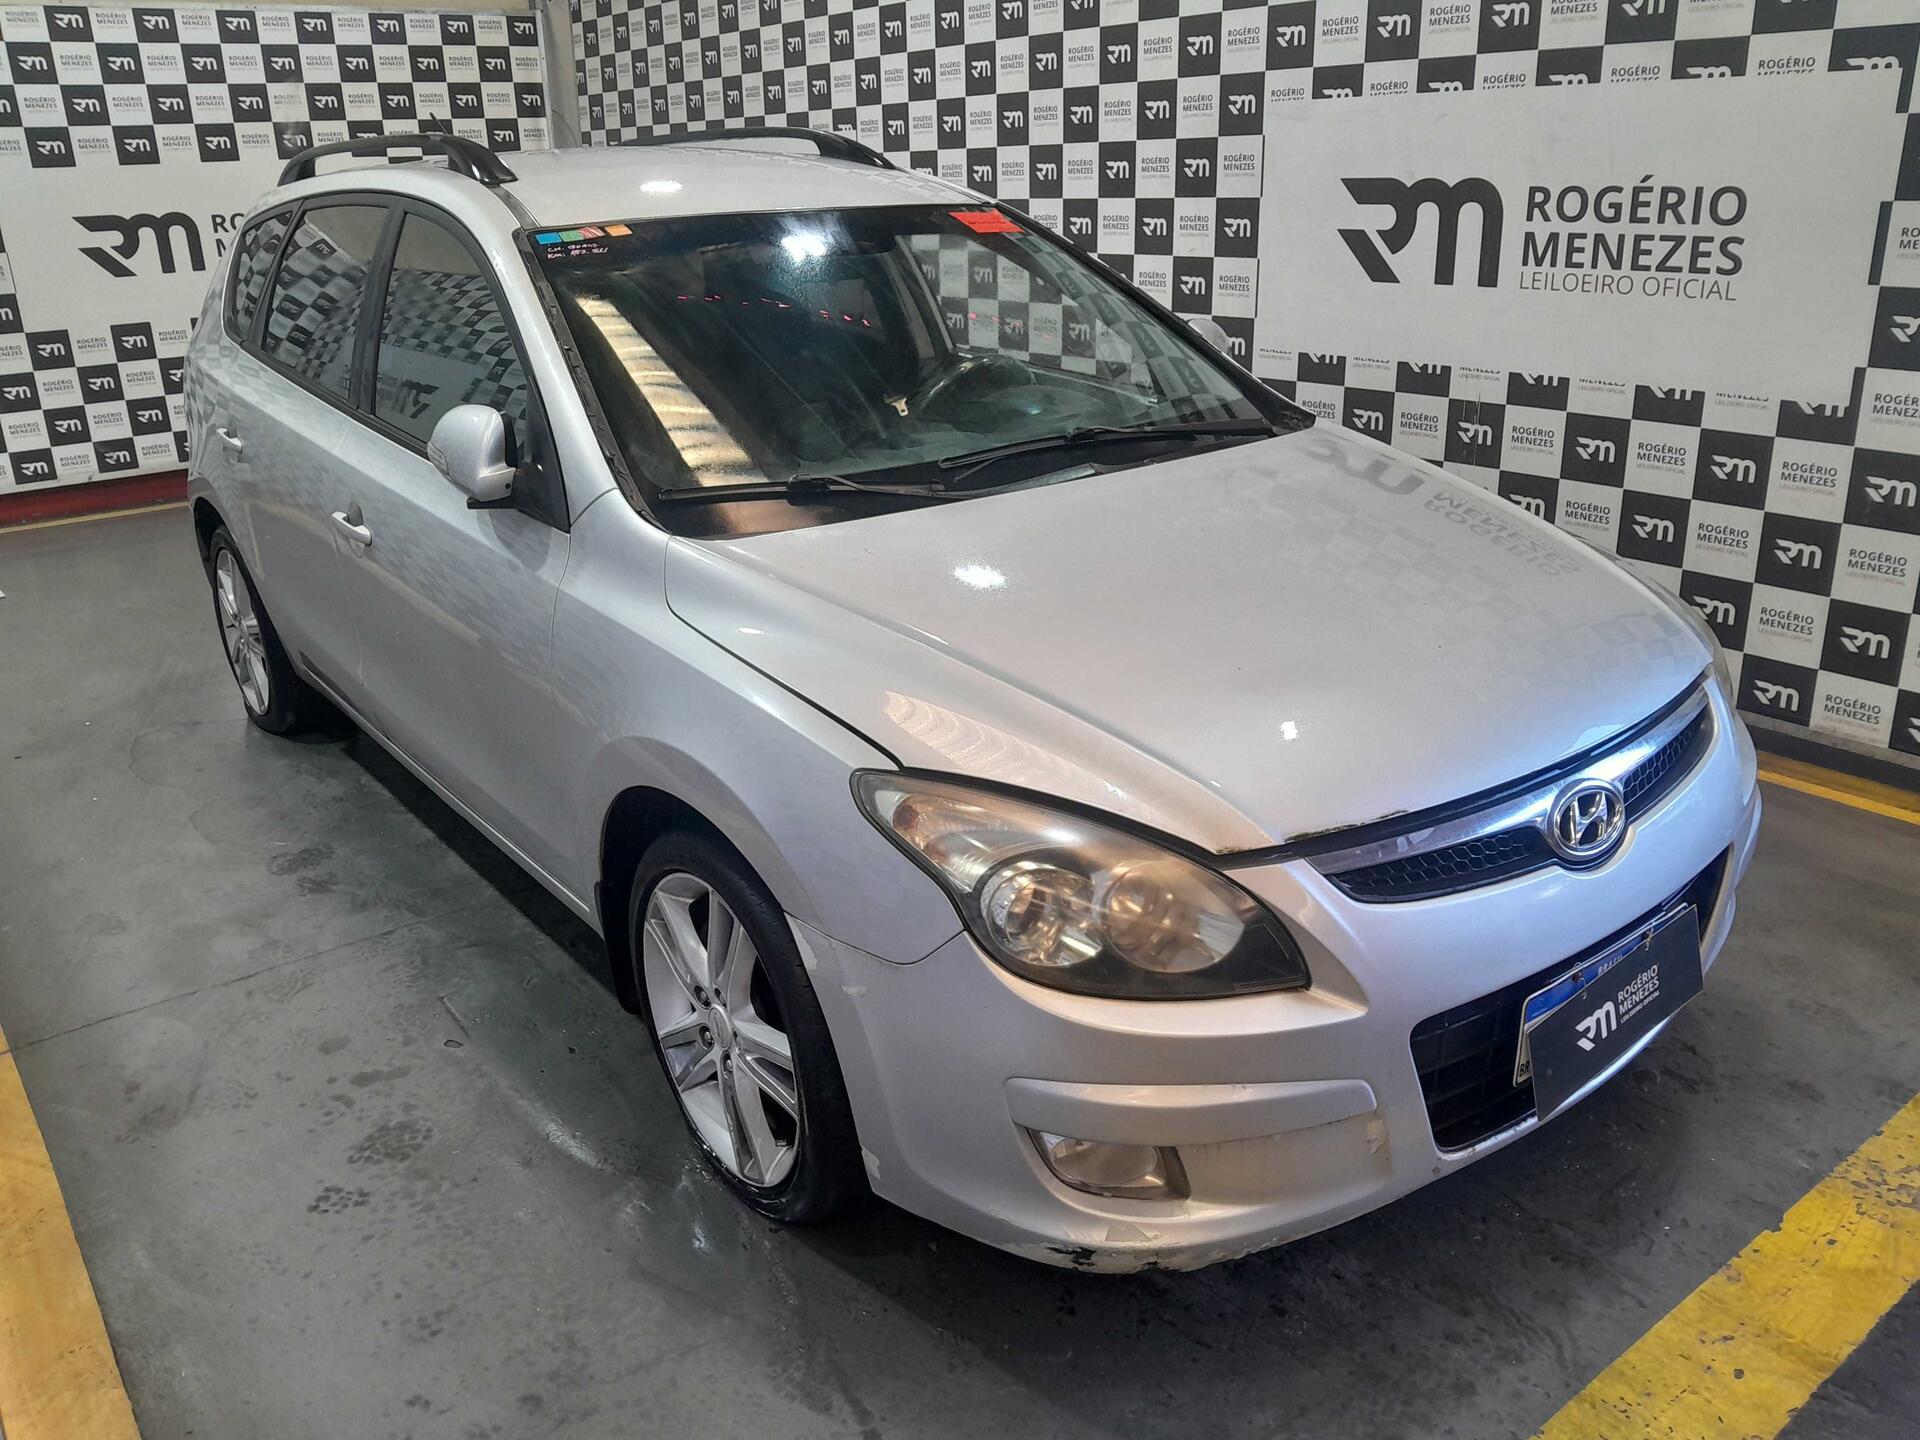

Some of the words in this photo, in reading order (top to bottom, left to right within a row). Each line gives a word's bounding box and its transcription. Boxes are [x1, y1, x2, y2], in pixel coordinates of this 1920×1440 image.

[968, 3, 991, 13] ROGÉRIO
[1429, 4, 1471, 16] ROGÉRIO
[1550, 2, 1598, 15] MENEZES
[968, 10, 991, 20] MENEZES
[1428, 14, 1471, 26] MENEZES
[1322, 15, 1359, 28] ROGÉRIO
[1227, 26, 1260, 38] ROGÉRIO
[1322, 25, 1359, 37] MENEZES
[1143, 36, 1172, 47] ROGÉRIO
[1227, 35, 1260, 46] MENEZES
[1068, 44, 1094, 55] ROGÉRIO
[1143, 44, 1173, 55] MENEZES
[1000, 52, 1024, 62] ROGÉRIO
[1068, 53, 1095, 63] MENEZES
[1758, 55, 1816, 70] ROGÉRIO
[939, 60, 961, 70] ROGÉRIO
[1000, 60, 1024, 70] MENEZES
[1610, 64, 1661, 77] ROGÉRIO
[939, 68, 962, 77] MENEZES
[1482, 72, 1527, 85] ROGÉRIO
[1370, 79, 1409, 92] ROGÉRIO
[1271, 86, 1305, 98] ROGÉRIO
[1104, 98, 1131, 109] ROGÉRIO
[1182, 93, 1213, 104] ROGÉRIO
[1033, 104, 1058, 114] ROGÉRIO
[1104, 108, 1132, 117] MENEZES
[1182, 102, 1213, 112] MENEZES
[1033, 112, 1059, 121] MENEZES
[1068, 158, 1093, 167] ROGÉRIO
[1141, 155, 1170, 165] ROGÉRIO
[1223, 152, 1255, 163] ROGÉRIO
[1067, 167, 1094, 175] MENEZES
[1141, 165, 1170, 173] MENEZES
[1223, 162, 1255, 171] MENEZES
[1524, 174, 1748, 226] ROGÉRIO
[1102, 213, 1130, 223] ROGÉRIO
[1179, 213, 1209, 224] ROGÉRIO
[1102, 222, 1130, 230] MENEZES
[1179, 223, 1209, 232] MENEZES
[1522, 229, 1746, 276] MENEZES
[1138, 270, 1167, 280] ROGÉRIO
[1219, 274, 1250, 284] ROGÉRIO
[1138, 279, 1167, 288] MENEZES
[1218, 283, 1250, 292] MENEZES
[1519, 270, 1634, 297] LEILOEIRO
[1642, 275, 1738, 301] OFICIAL
[1873, 393, 1920, 407] ROGÉR
[1400, 411, 1438, 424] ROGÉRIO
[1871, 404, 1920, 420] MENEZ
[1400, 420, 1438, 433] MENEZES
[1512, 425, 1555, 439] ROGÉRIO
[1511, 434, 1554, 448] MENEZES
[1637, 442, 1687, 457] ROGÉRIO
[1636, 451, 1686, 467] MENEZES
[1781, 461, 1838, 478] ROGÉRIO
[1780, 471, 1837, 488] MENEZES
[1565, 500, 1611, 516] ROGÉRIO
[1564, 509, 1610, 525] MENEZES
[1698, 522, 1750, 539] ROGÉRIO
[1696, 532, 1748, 550] MENEZES
[1848, 548, 1908, 567] ROGÉRIO
[1846, 558, 1907, 578] MENEZES
[1760, 606, 1814, 626] ROGÉRIO
[1758, 616, 1813, 636] MENEZES
[1824, 693, 1882, 715] ROGÉRIO
[1823, 703, 1880, 725] MENEZES
[1618, 964, 1658, 1004] ROGÉRIO
[1619, 976, 1660, 1015] MENEZES
